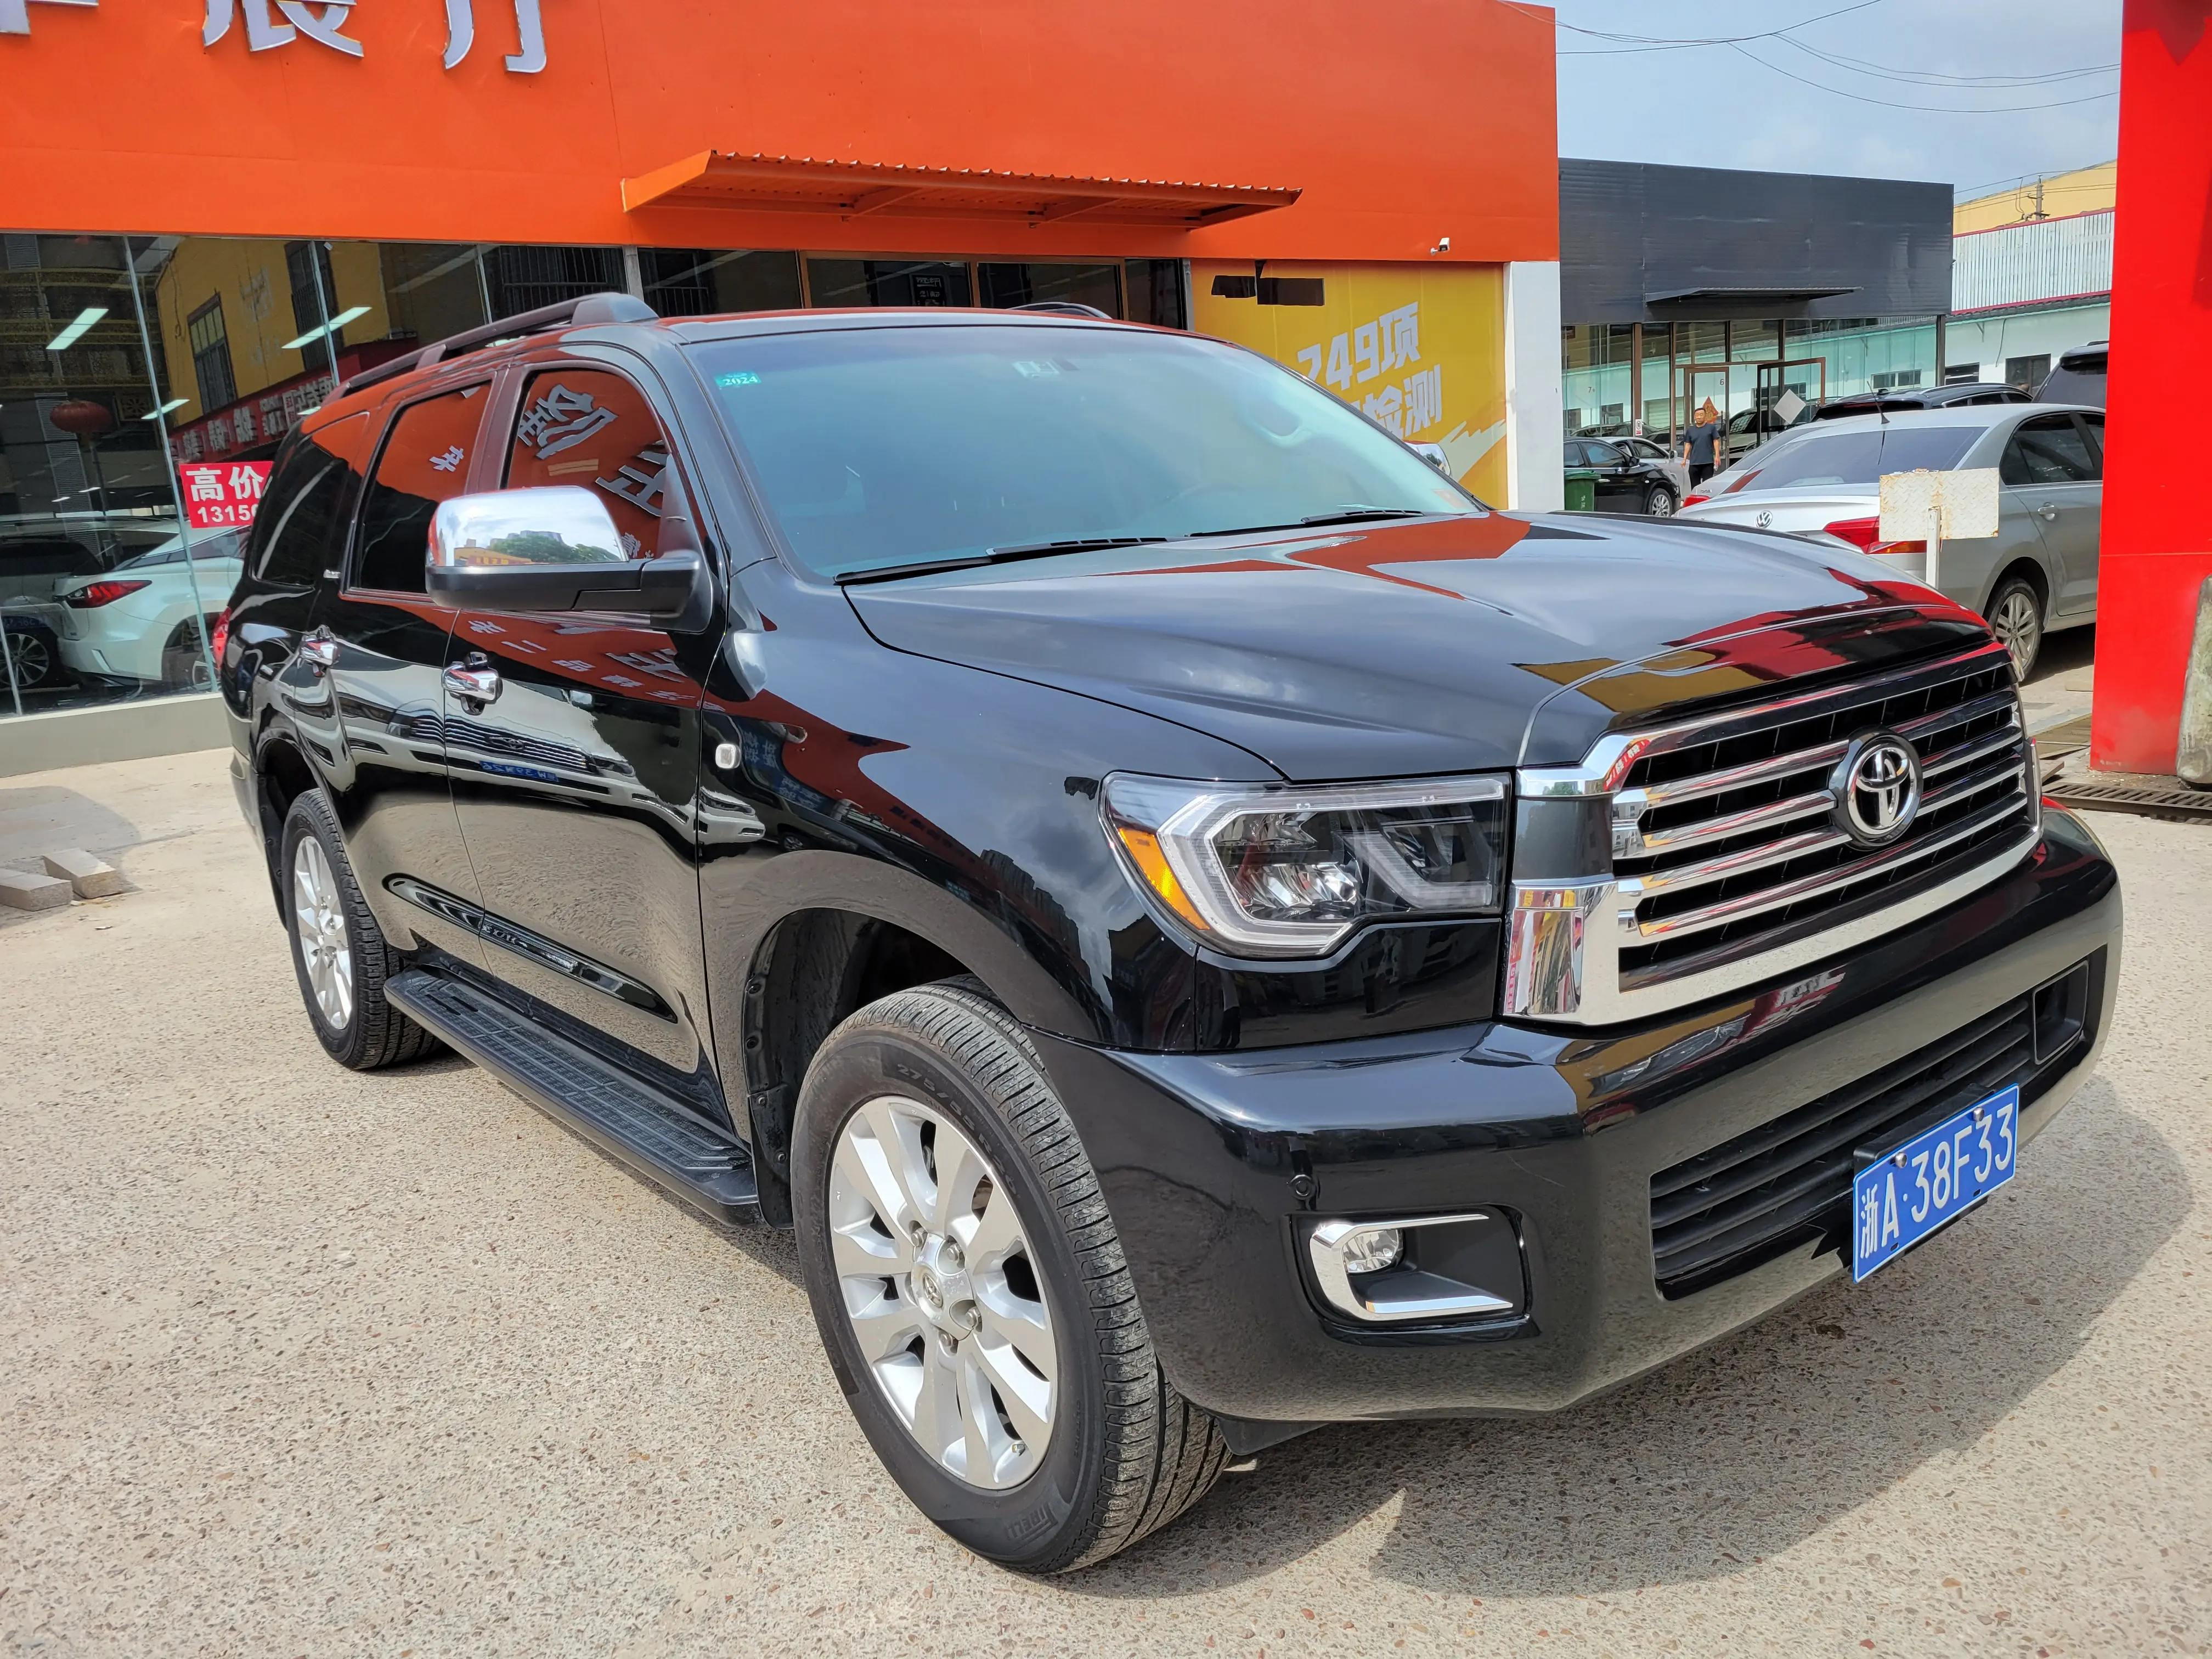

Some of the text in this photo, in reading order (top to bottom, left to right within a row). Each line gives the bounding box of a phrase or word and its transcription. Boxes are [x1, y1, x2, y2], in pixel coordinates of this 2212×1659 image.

[722, 376, 758, 385] 2024
[1350, 363, 1442, 439] 检测
[185, 465, 264, 502] 高价
[1860, 1103, 2013, 1259] 浙A·38F33
